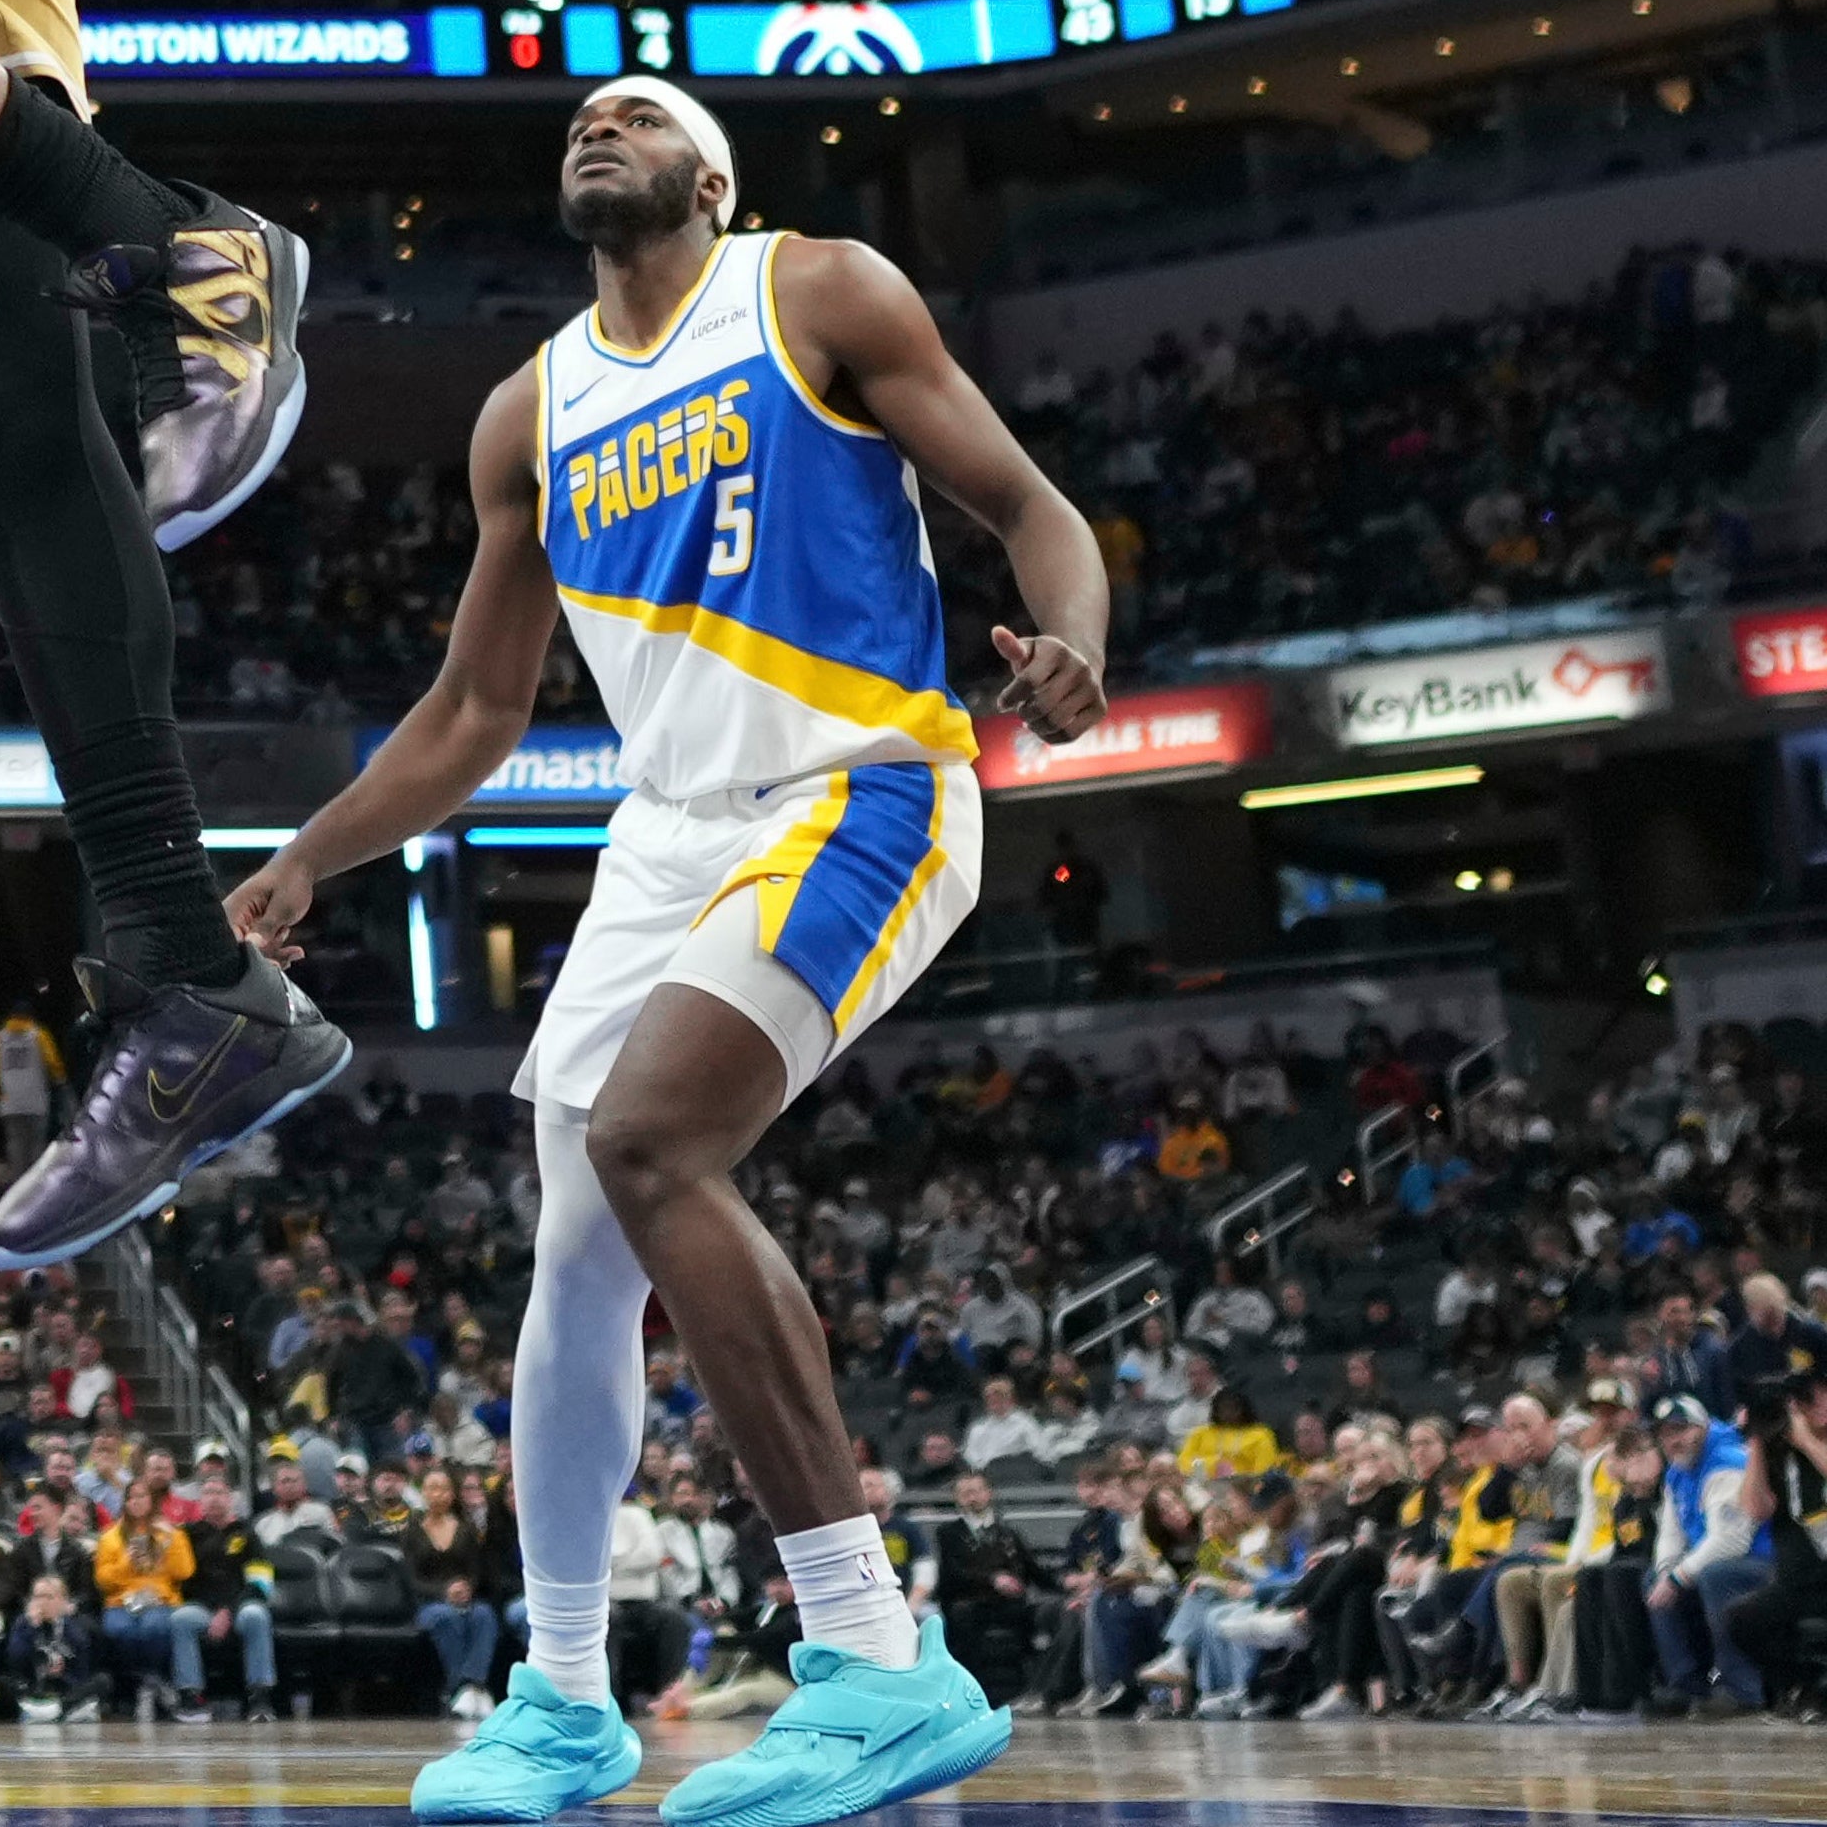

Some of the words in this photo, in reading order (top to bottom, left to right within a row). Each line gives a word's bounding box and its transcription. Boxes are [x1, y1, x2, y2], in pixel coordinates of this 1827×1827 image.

[223, 21, 409, 63] WIZARDS
[511, 34, 540, 68] 0
[642, 33, 669, 68] 4
[691, 315, 727, 340] LUCAS
[730, 307, 748, 323] OIL
[569, 379, 751, 541] PACERS
[708, 475, 754, 577] 5
[1342, 669, 1542, 731] KeyBank
[1150, 710, 1221, 750] TIRE
